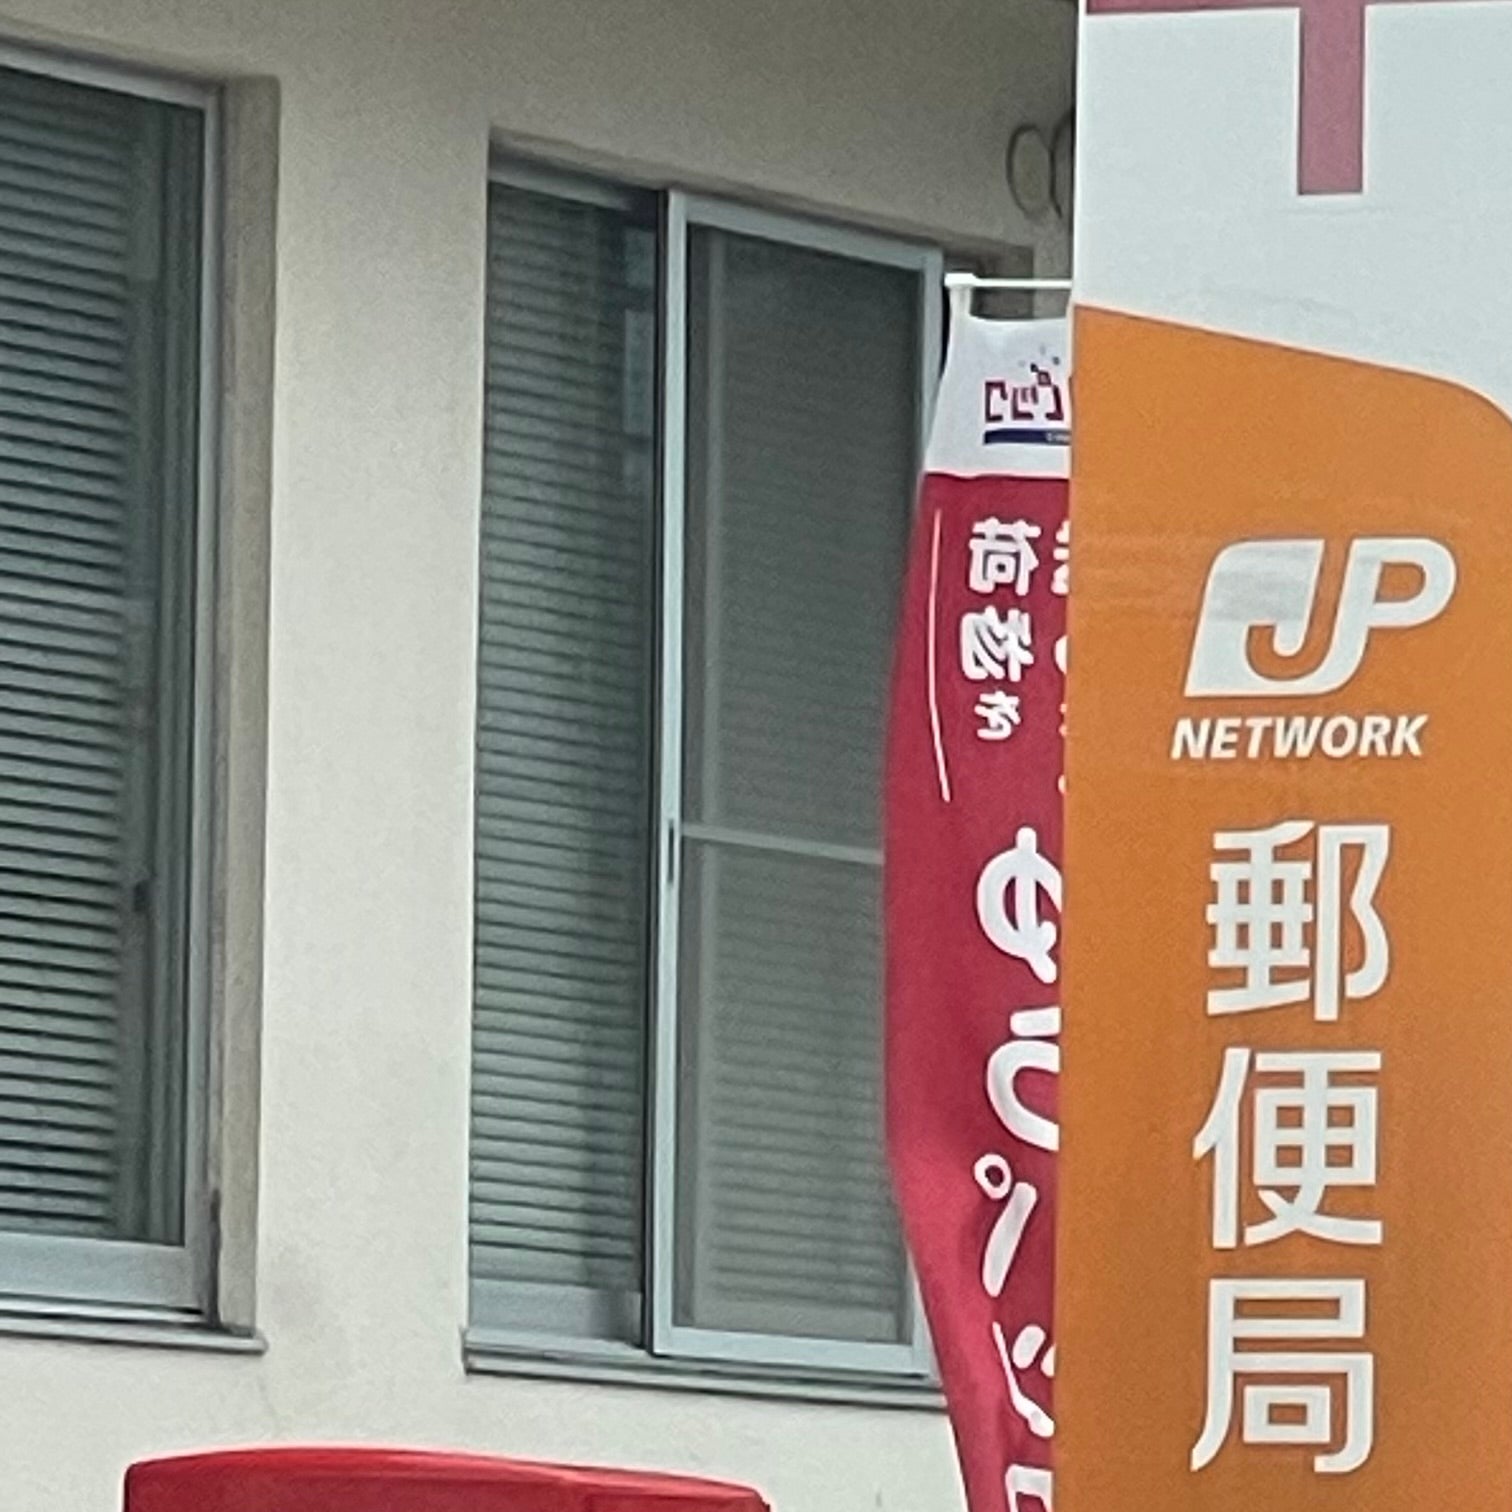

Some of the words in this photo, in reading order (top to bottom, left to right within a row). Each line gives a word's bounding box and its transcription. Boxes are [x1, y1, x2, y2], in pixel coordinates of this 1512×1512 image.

[1184, 538, 1457, 697] JP
[1171, 714, 1429, 760] NETWORK
[1191, 820, 1390, 1474] 郵便局
